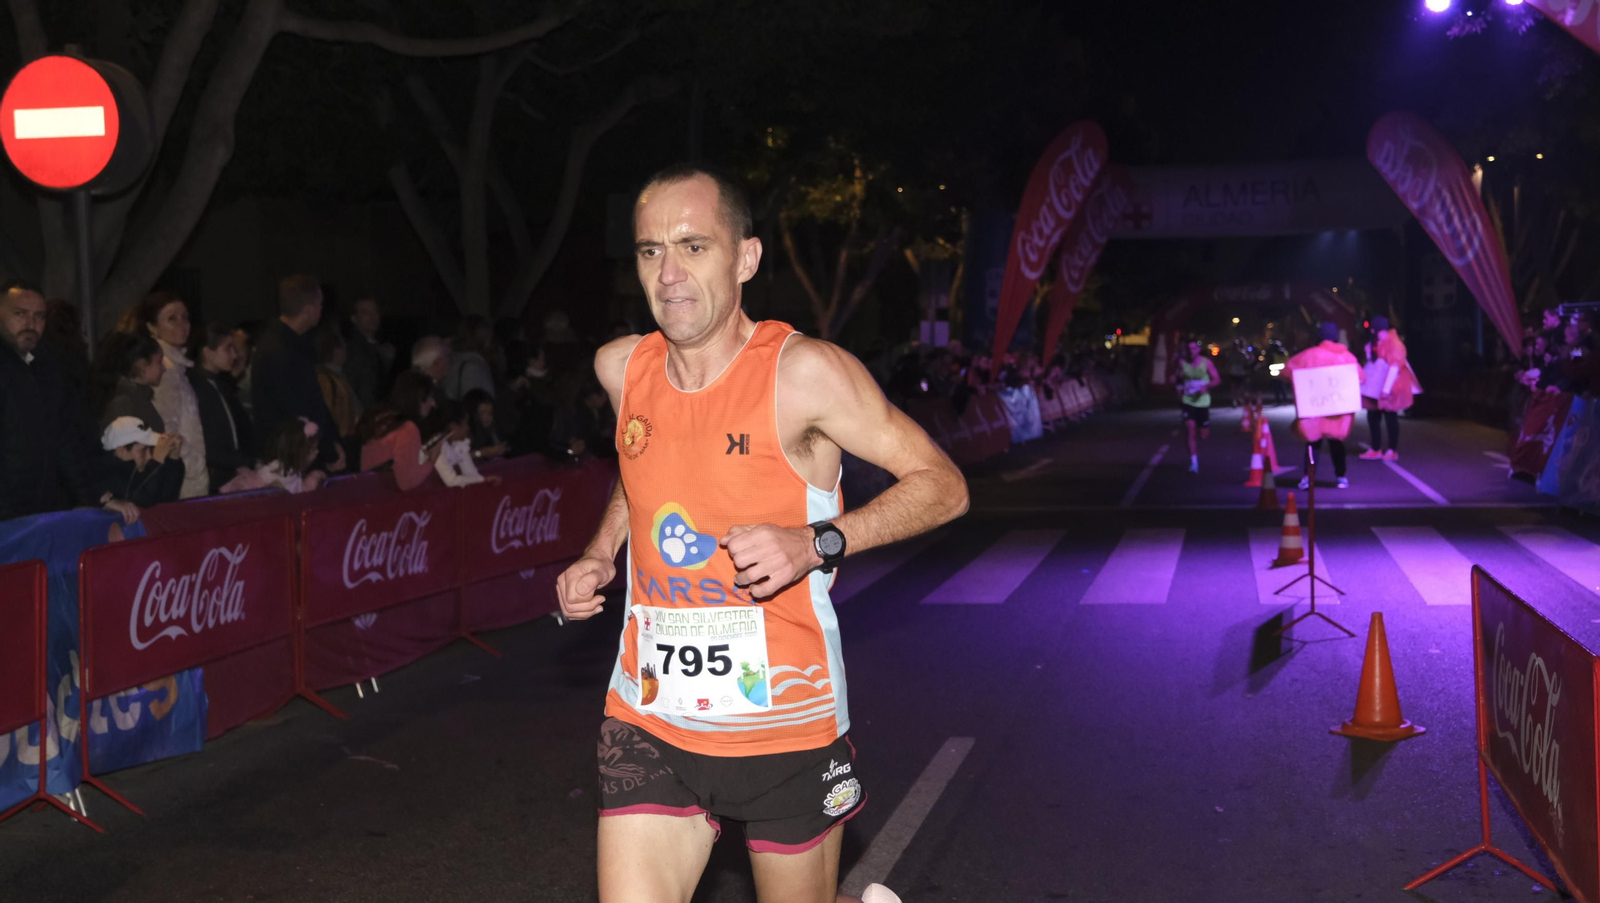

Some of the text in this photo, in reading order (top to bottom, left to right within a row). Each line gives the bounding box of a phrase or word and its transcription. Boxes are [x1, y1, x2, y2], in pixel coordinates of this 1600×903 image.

[1017, 131, 1101, 280] Coca-Cola
[342, 509, 433, 590] Coca-Cola
[491, 487, 564, 555] Coca-Cola
[129, 542, 250, 652] Coca-Cola
[655, 623, 688, 637] CIUDAD
[690, 625, 705, 637] DE
[668, 612, 690, 624] SAN
[692, 609, 754, 624] SILVESTRE
[656, 643, 733, 677] 795
[1492, 621, 1562, 809] Coca-Cola
